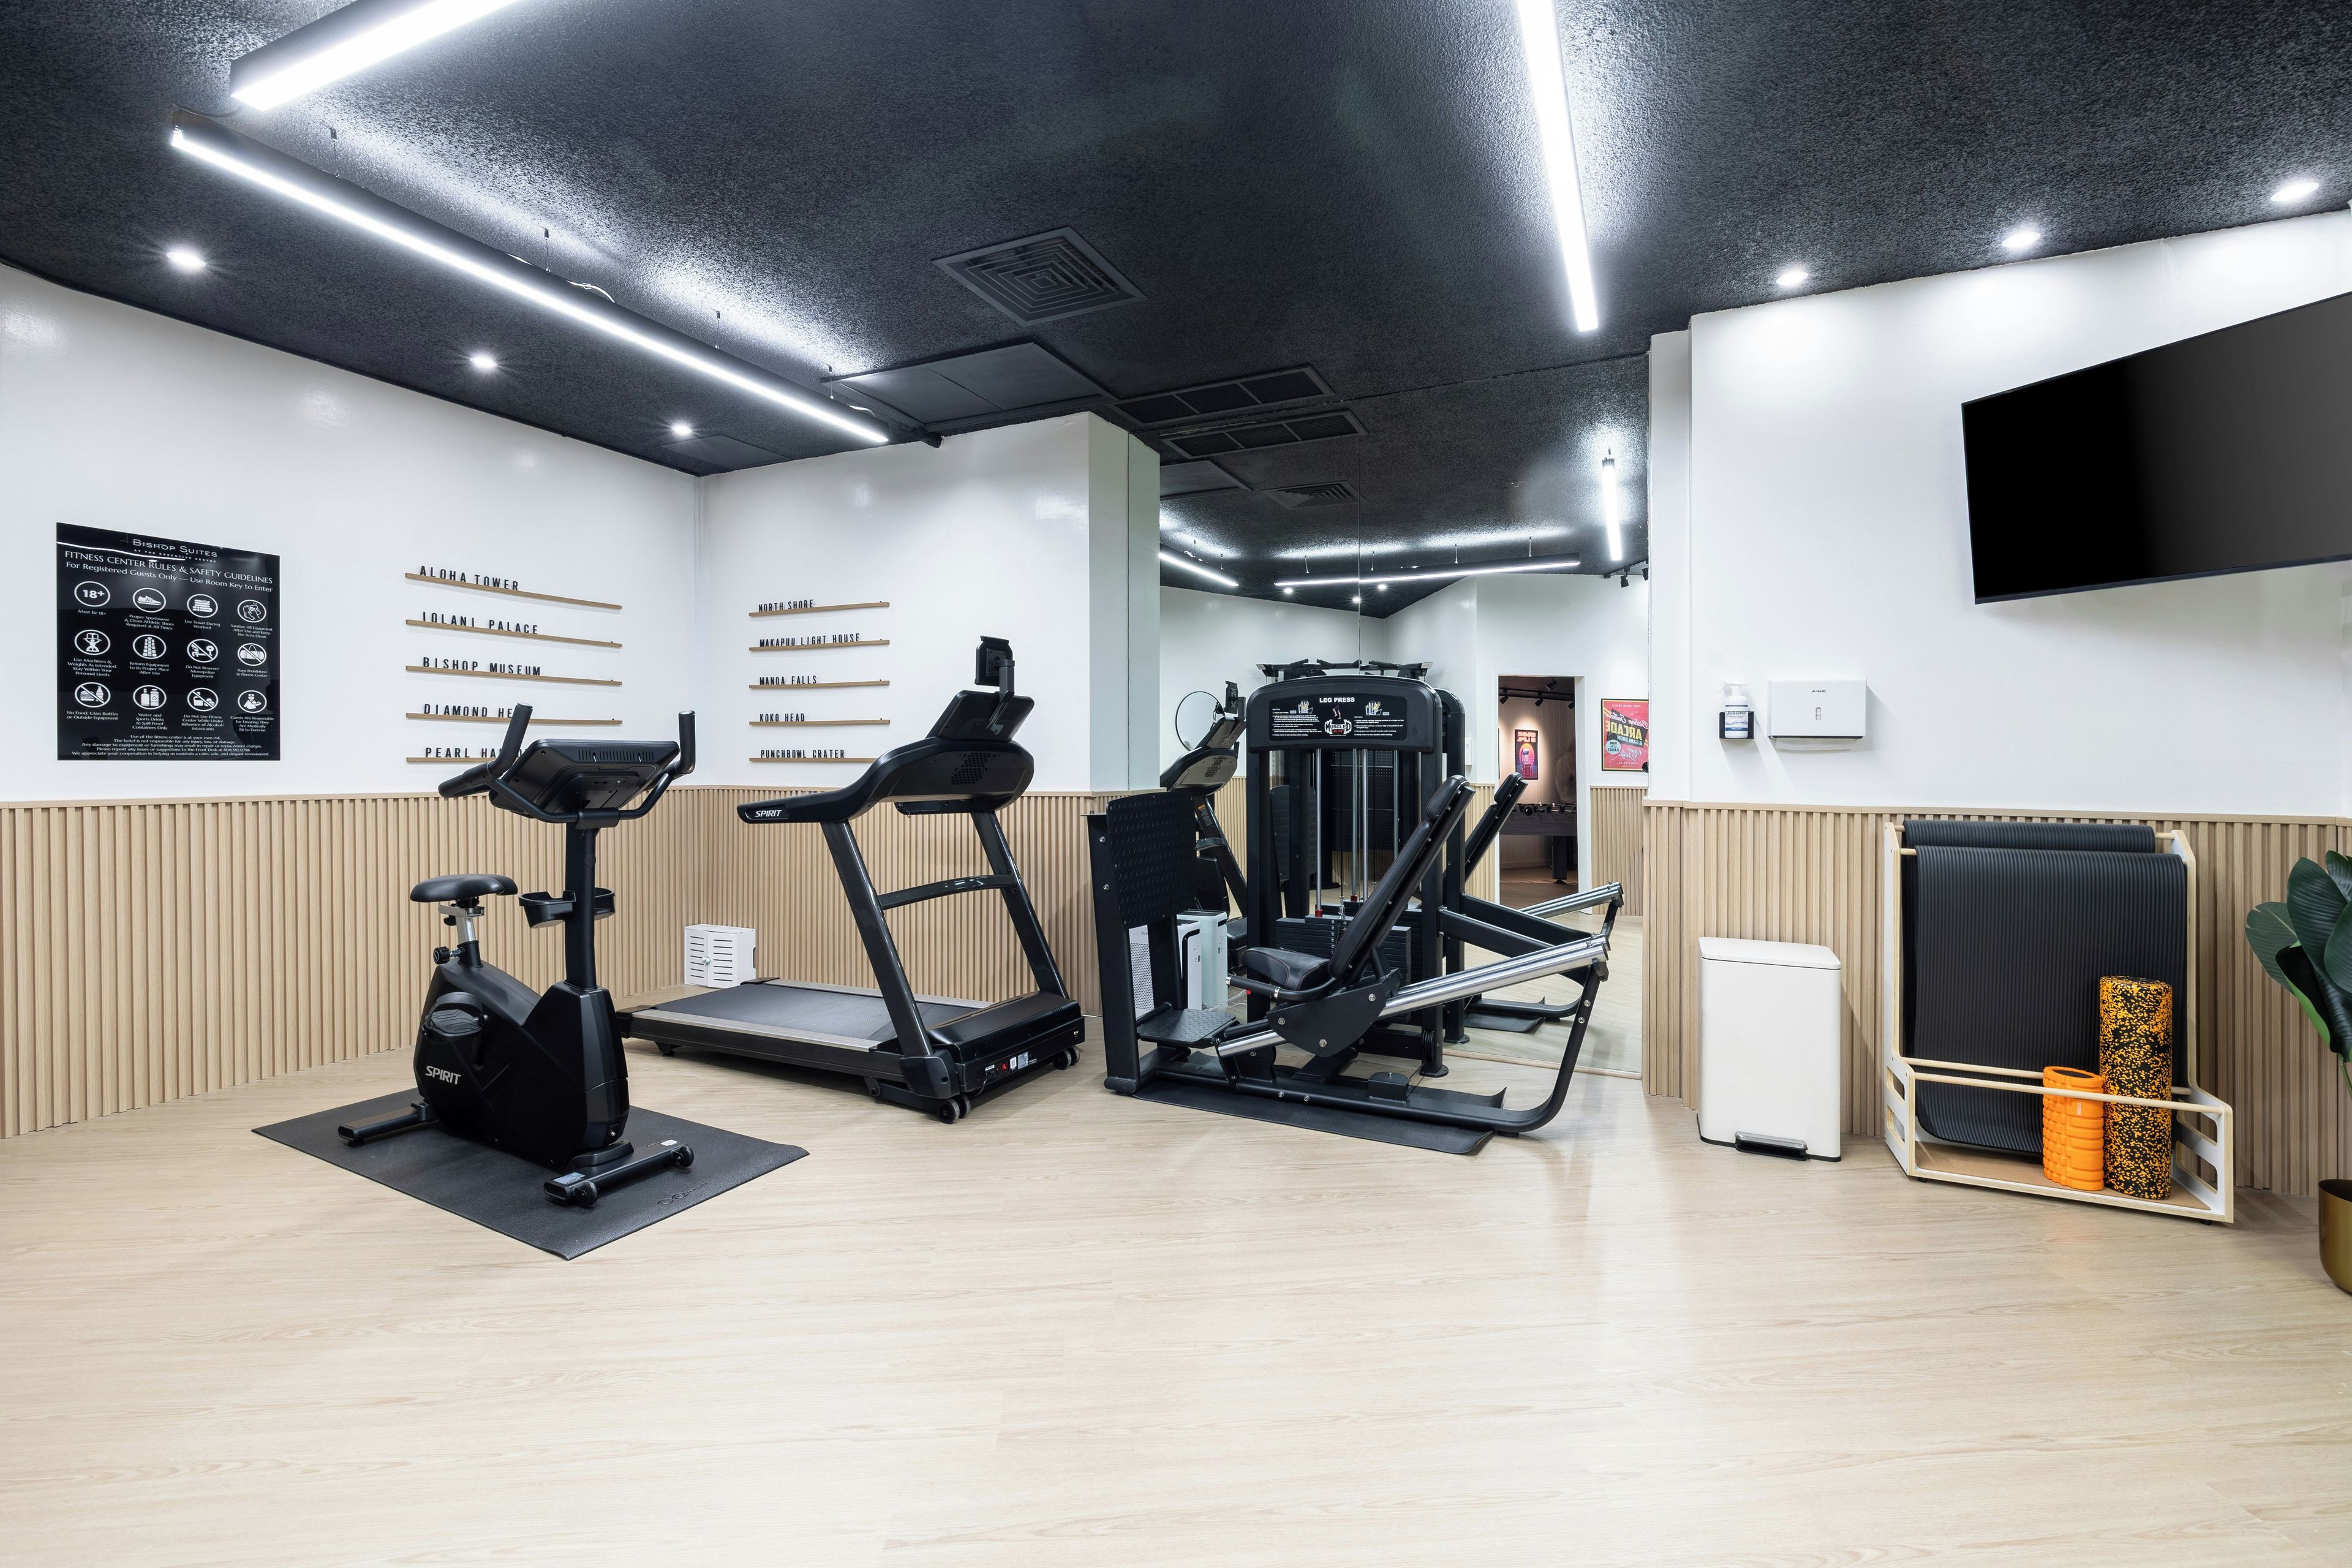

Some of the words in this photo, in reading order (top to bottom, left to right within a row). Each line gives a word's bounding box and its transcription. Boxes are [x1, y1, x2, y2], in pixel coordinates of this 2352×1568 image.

[133, 538, 176, 551] BISHOP
[179, 546, 217, 557] SUITES
[65, 551, 104, 562] FITNESS
[107, 556, 146, 567] CENTER
[149, 561, 176, 571] RULES
[179, 566, 189, 575] &
[189, 567, 222, 577] SAFETY
[224, 571, 273, 584] GUIDELINES
[83, 563, 127, 575] Registered
[130, 569, 156, 578] Guests
[158, 573, 178, 582] Only
[420, 565, 467, 582] ALOHA
[474, 575, 519, 591] TOWER
[83, 589, 105, 598] 18+
[758, 601, 783, 612] NORTH
[788, 599, 813, 609] SHORE
[423, 611, 475, 628] IOLANI
[489, 619, 538, 635] PALACE
[760, 637, 796, 647] MAKAPUU
[801, 635, 826, 646] LIGHT
[832, 633, 859, 643] HOUSE
[423, 657, 478, 672] BISHOP
[489, 662, 540, 676] MUSEUM
[760, 676, 785, 685] MANOA
[791, 675, 817, 684] FALLS
[424, 704, 488, 717] DIAMOND
[498, 708, 513, 718] HE
[760, 714, 779, 722] KOKO
[785, 713, 805, 722] HEAD
[1326, 723, 1351, 731] MUSCLED
[425, 747, 470, 758] PEARL
[761, 749, 806, 758] PUNCHBOWL
[812, 749, 845, 758] CRATER
[425, 1066, 461, 1085] SPIRIT
